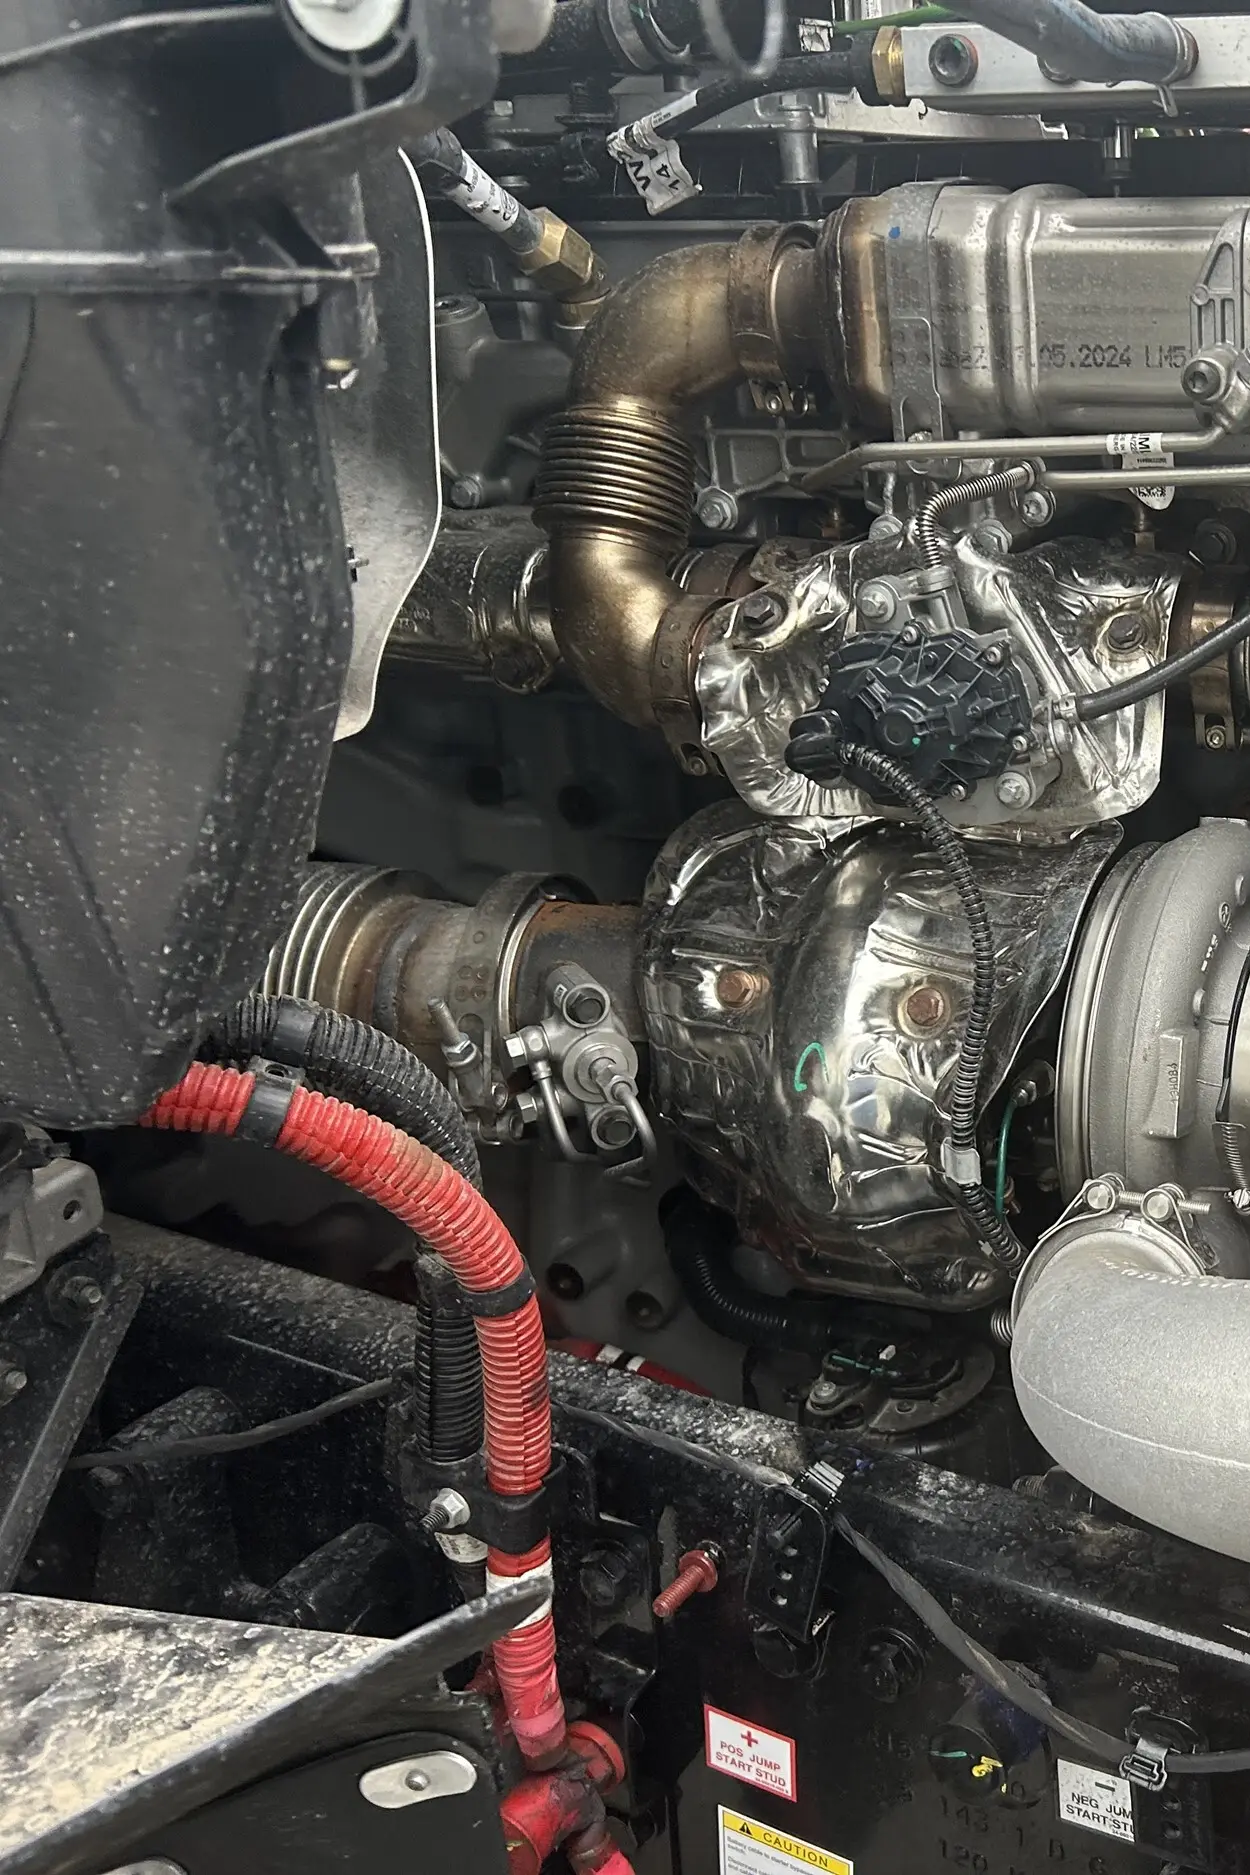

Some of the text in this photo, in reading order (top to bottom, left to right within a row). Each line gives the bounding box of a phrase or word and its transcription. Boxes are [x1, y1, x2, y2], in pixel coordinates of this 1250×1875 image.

[655, 163, 682, 191] 14
[715, 1751, 753, 1773] START
[755, 1768, 787, 1787] STUD
[720, 1740, 781, 1772] POS JUMP
[1065, 1803, 1109, 1825] START
[1071, 1792, 1133, 1819] NEG JUM
[762, 1832, 829, 1868] CAUTION
